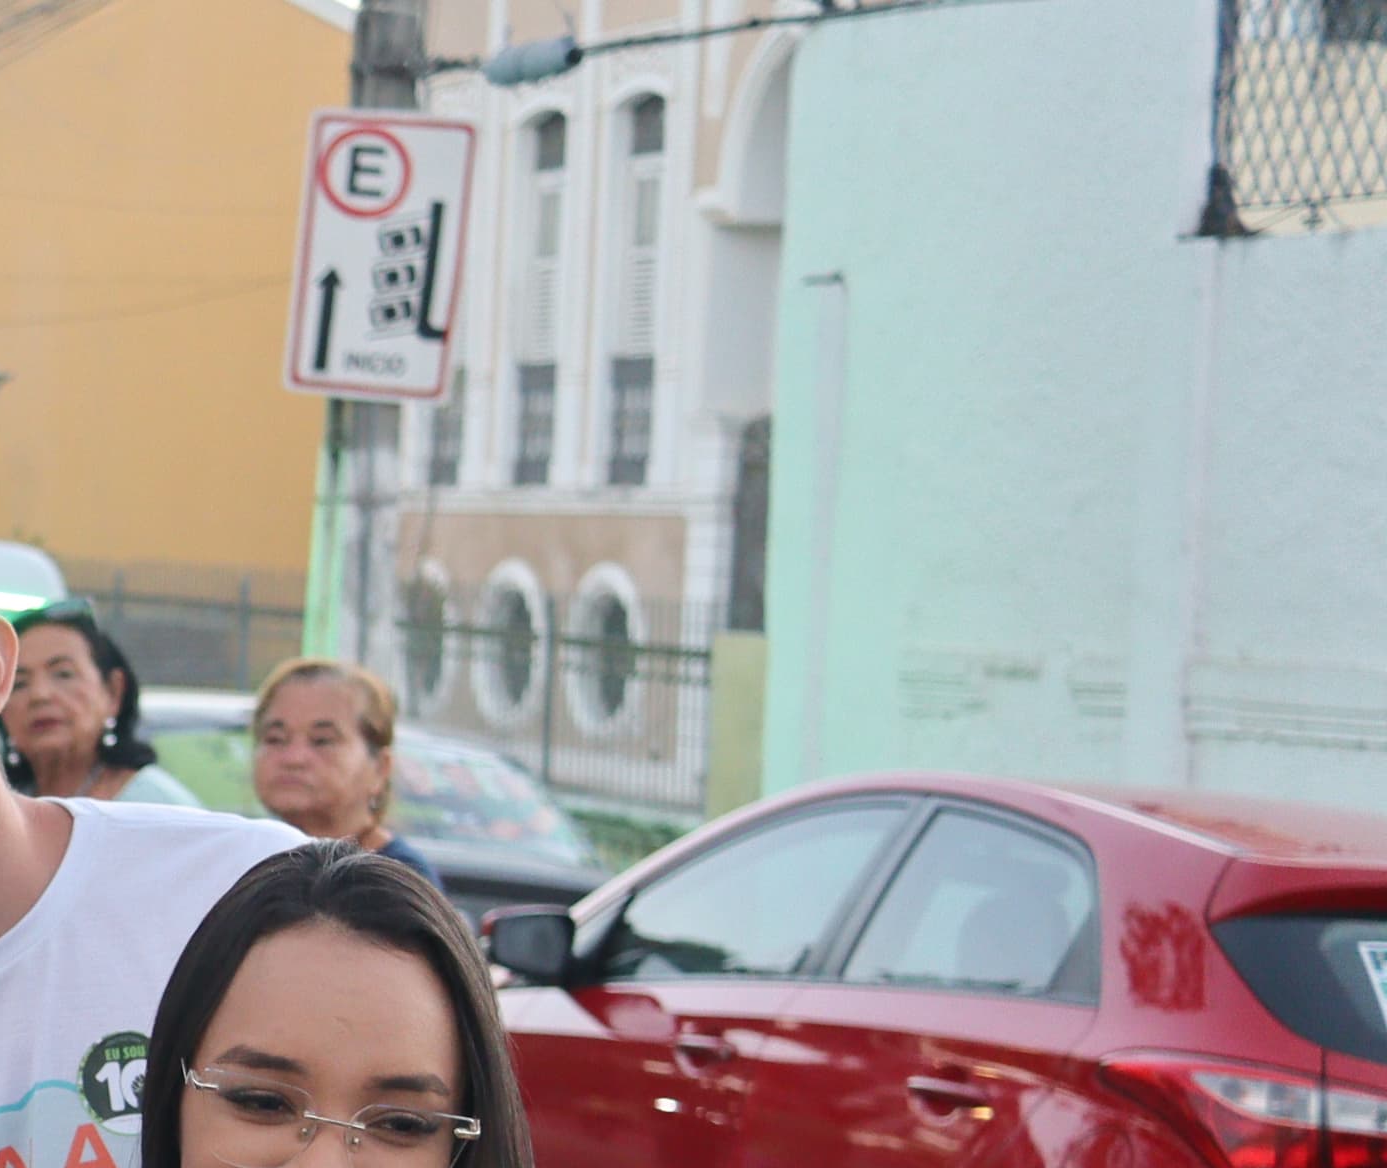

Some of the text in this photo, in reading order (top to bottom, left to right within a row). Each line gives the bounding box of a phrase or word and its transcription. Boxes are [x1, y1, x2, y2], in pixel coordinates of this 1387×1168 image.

[346, 145, 386, 196] E
[105, 1044, 146, 1060] EU SOU
